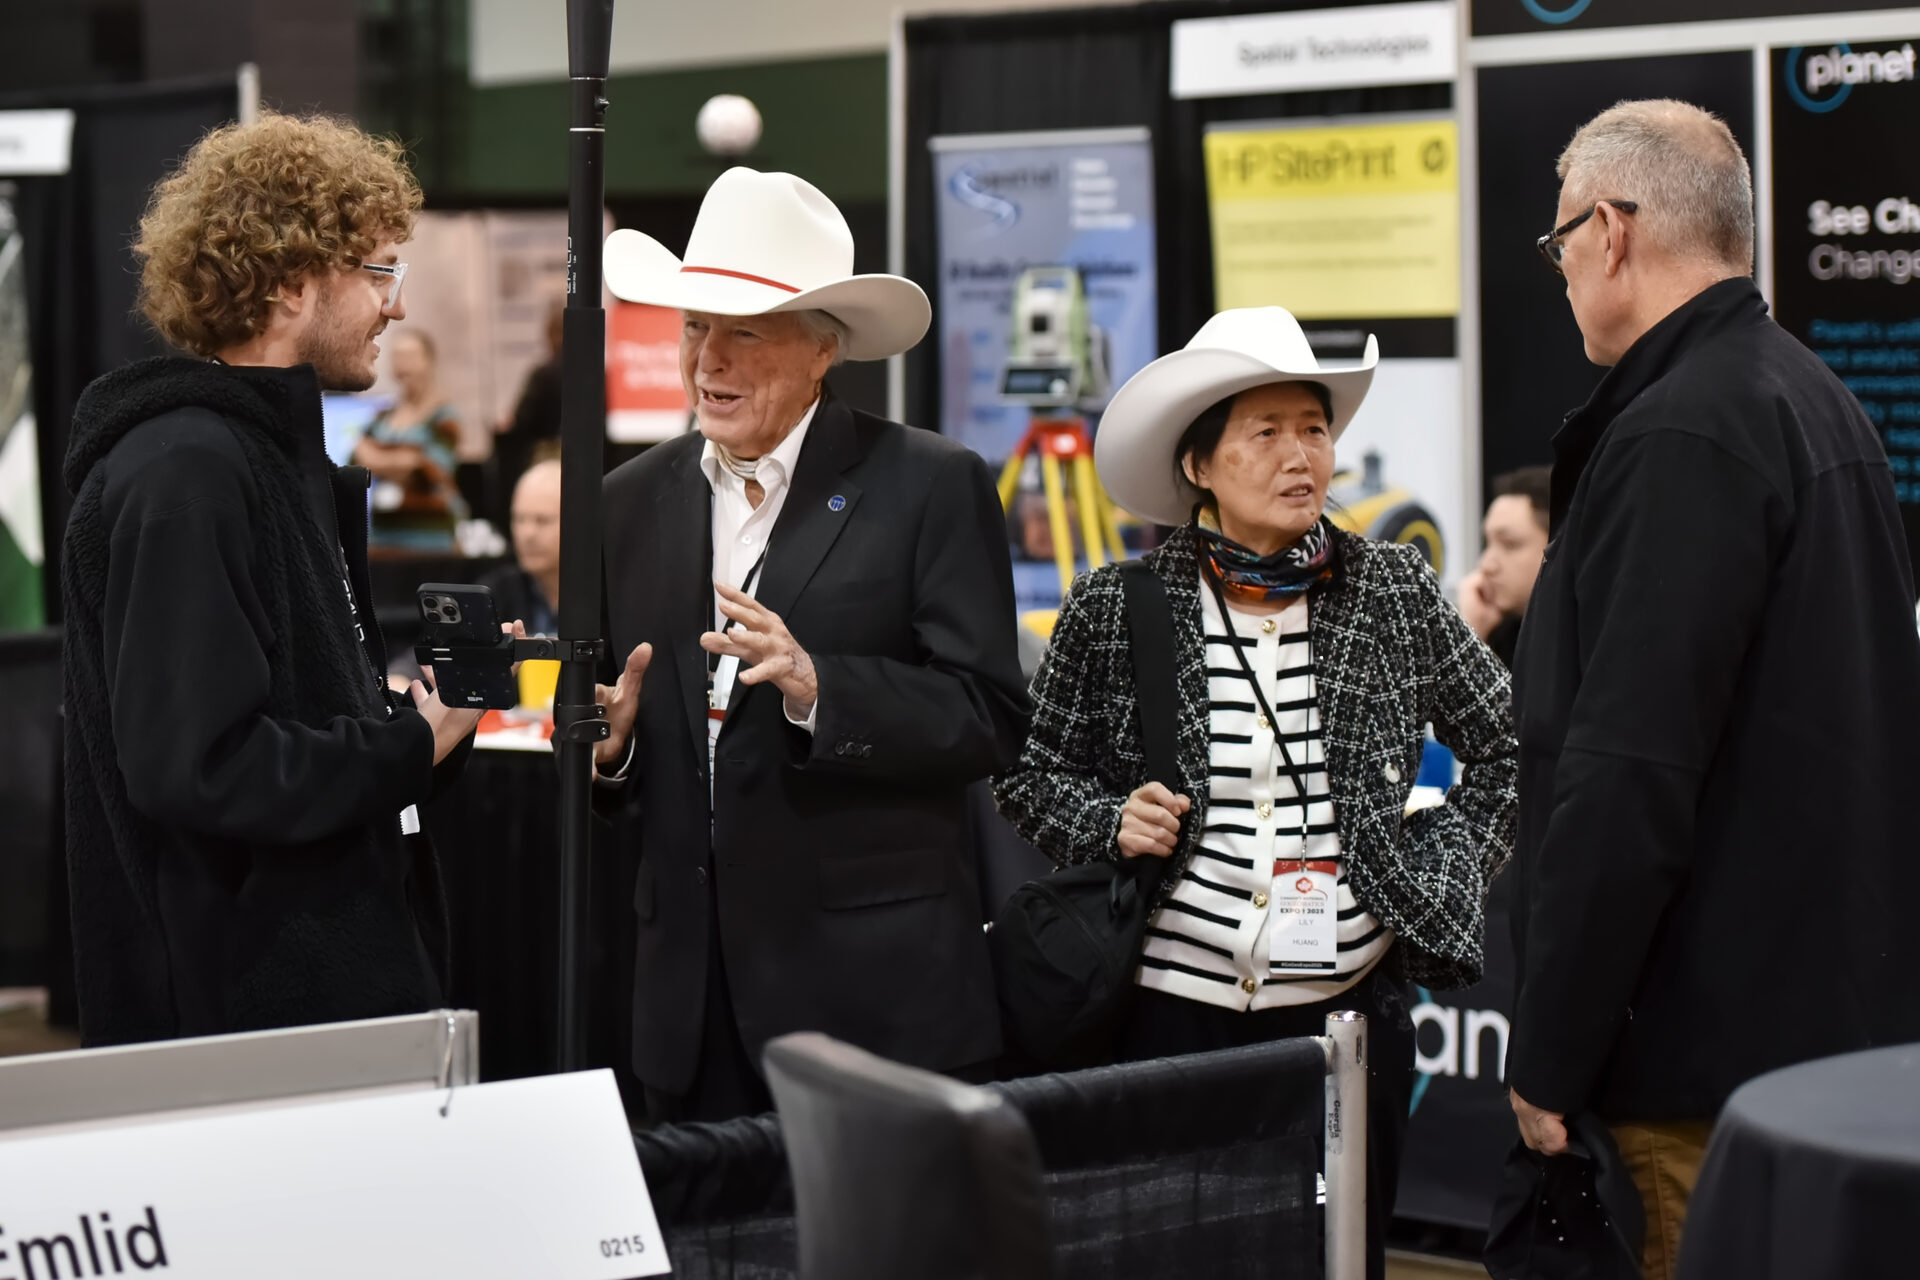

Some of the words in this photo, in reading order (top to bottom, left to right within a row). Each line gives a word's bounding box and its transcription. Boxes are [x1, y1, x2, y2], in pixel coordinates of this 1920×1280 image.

[1306, 35, 1429, 64] Technologies
[1806, 44, 1916, 93] planet
[1809, 200, 1870, 235] See
[0, 1206, 168, 1280] mlid
[600, 1235, 645, 1258] 0215
